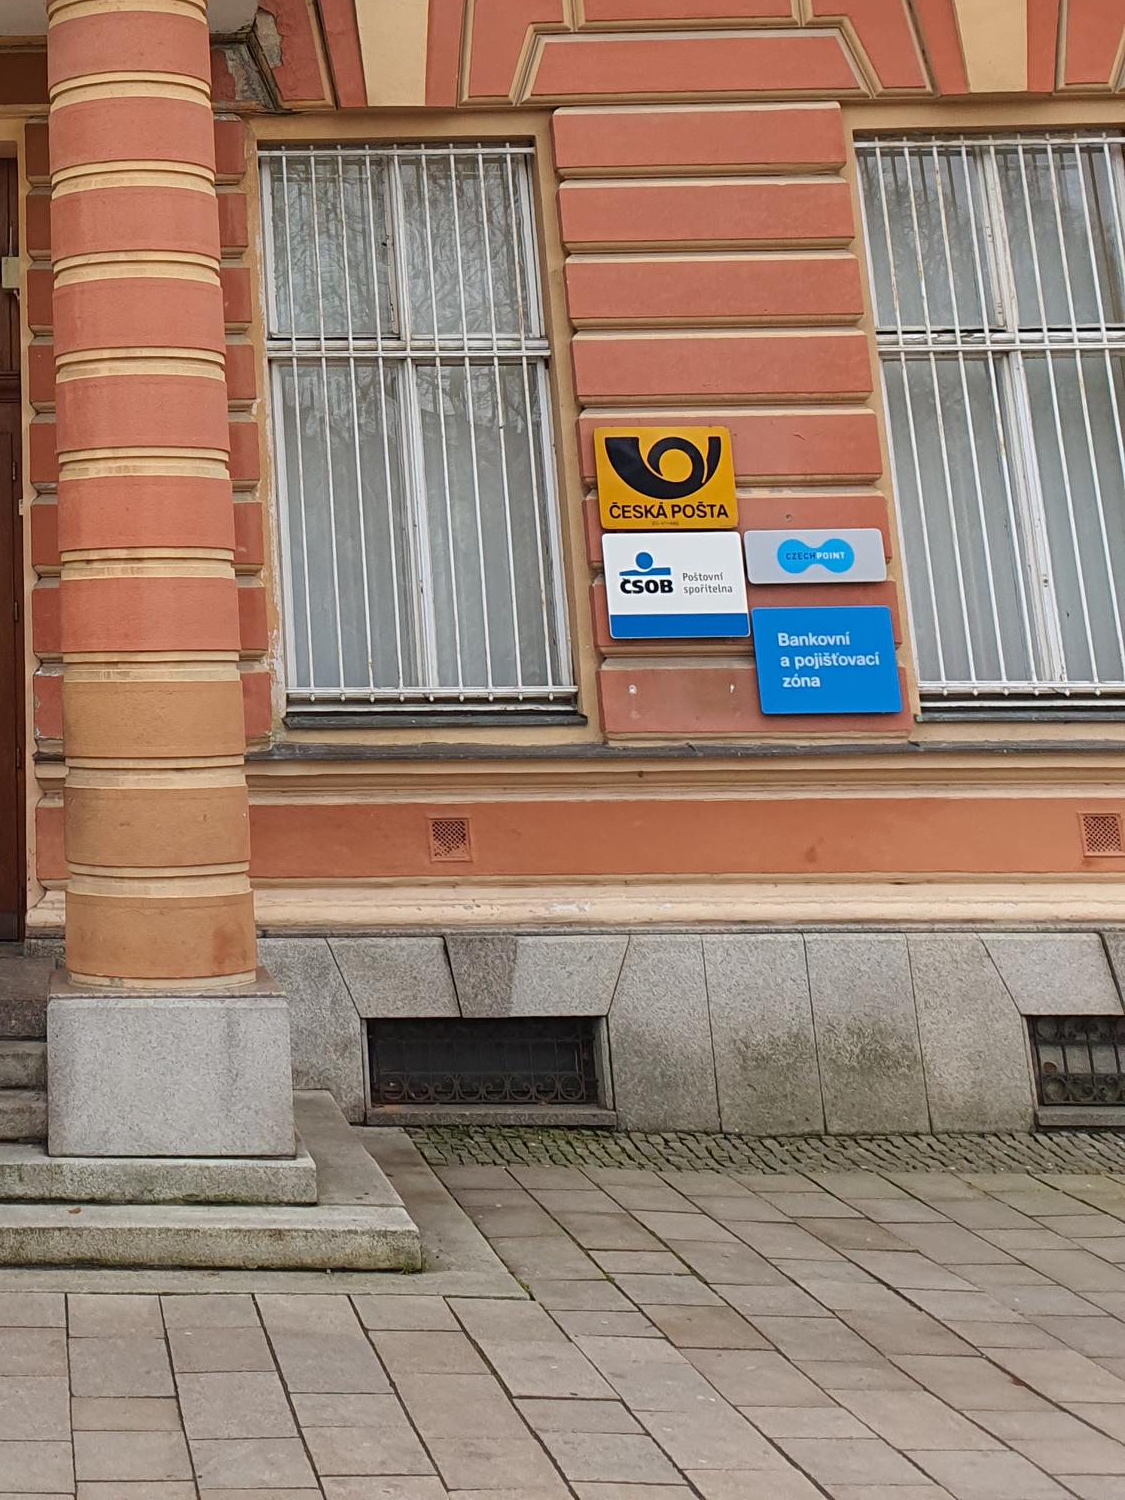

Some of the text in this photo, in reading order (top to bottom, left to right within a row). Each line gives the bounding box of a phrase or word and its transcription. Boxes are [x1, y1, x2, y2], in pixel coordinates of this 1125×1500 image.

[609, 501, 729, 519] ČESKÁ POŠTA
[682, 572, 724, 582] Poštovní
[620, 578, 674, 594] ČSOB
[683, 584, 733, 595] spořitelna
[777, 631, 851, 647] Bankovní
[780, 651, 881, 670] a pojišťovací
[782, 673, 821, 688] zóna
